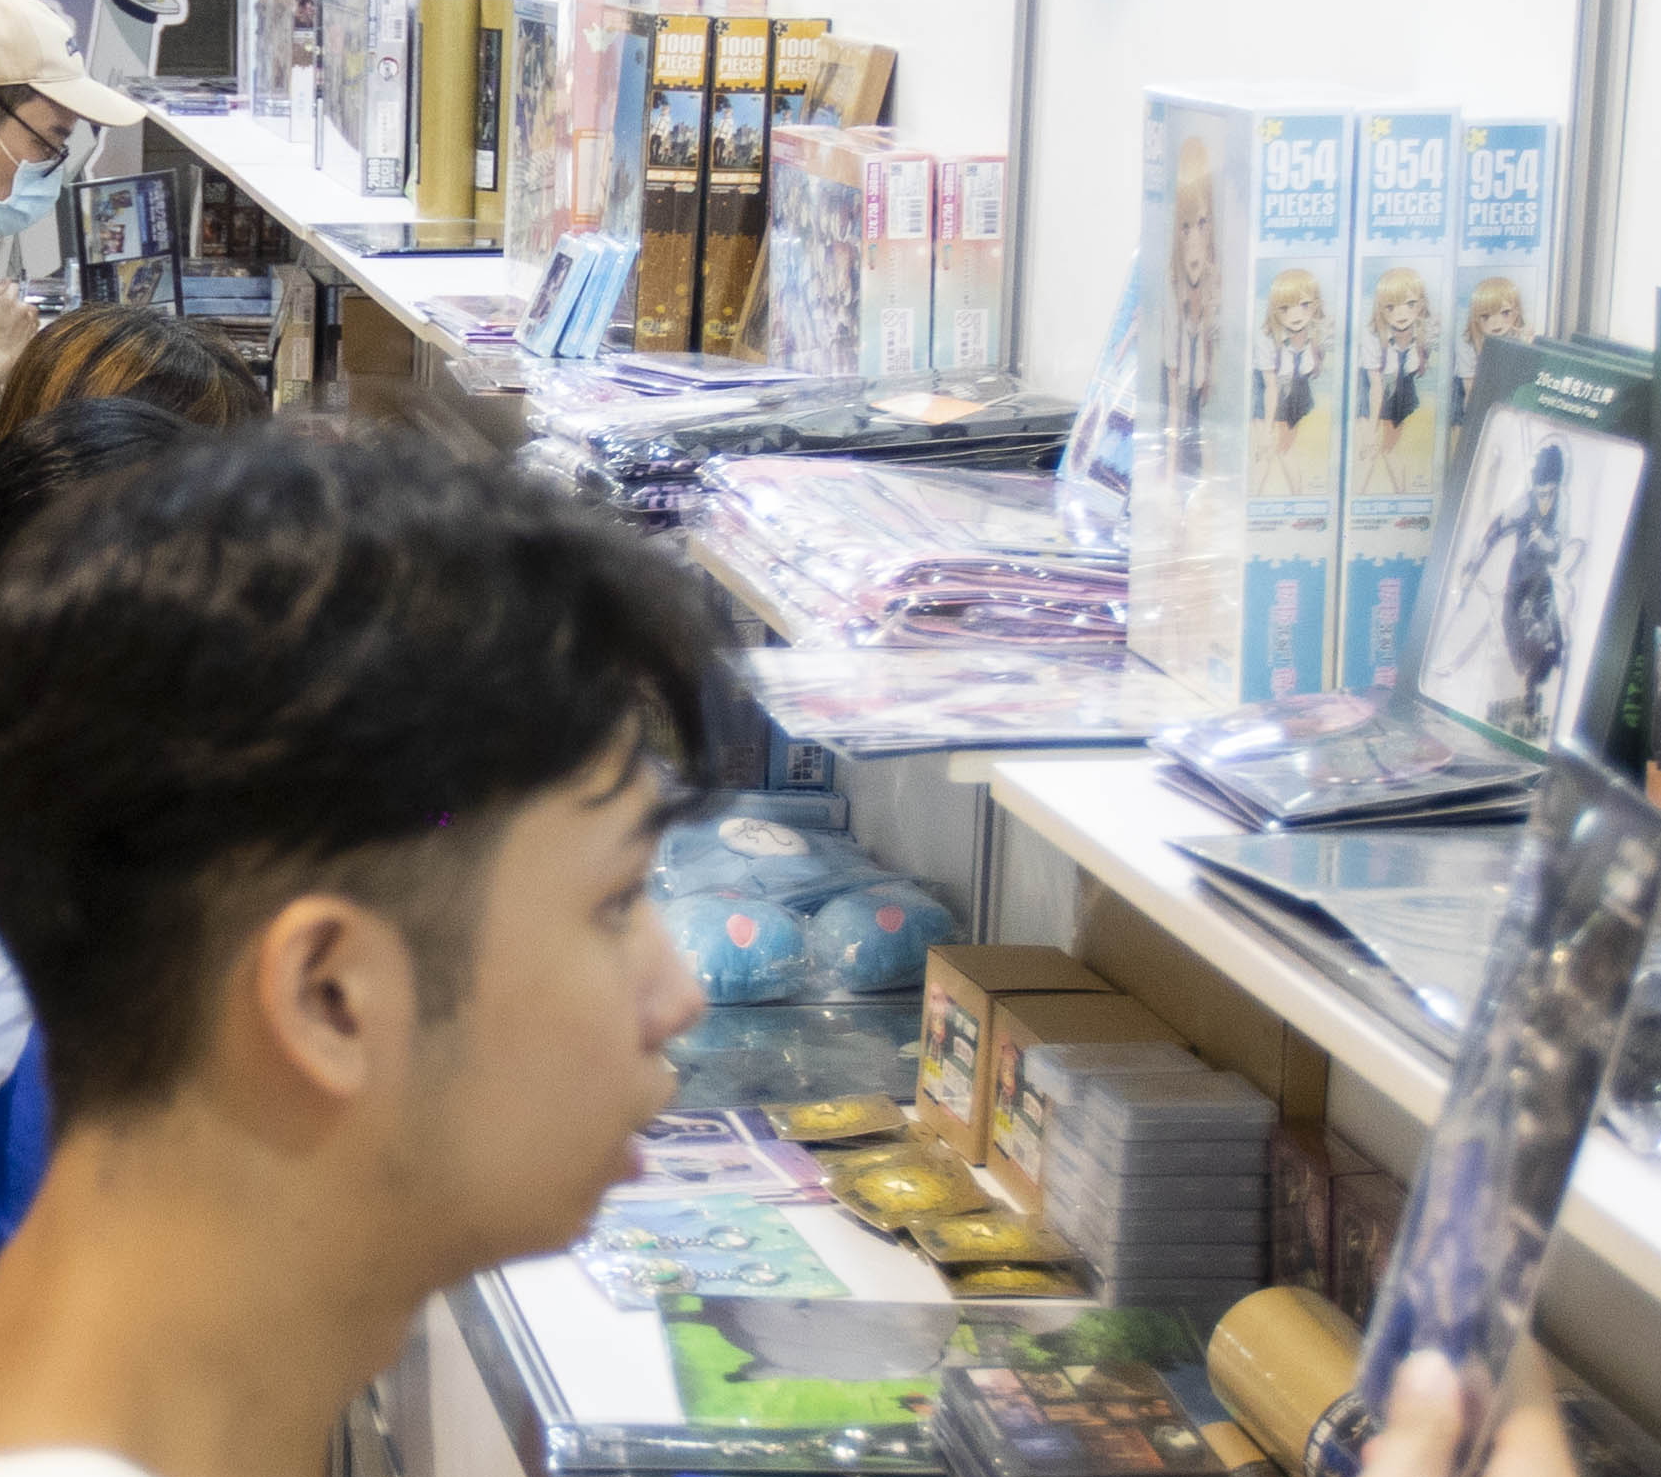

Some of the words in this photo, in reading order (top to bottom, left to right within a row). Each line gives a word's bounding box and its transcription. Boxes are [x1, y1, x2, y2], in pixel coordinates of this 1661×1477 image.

[719, 36, 766, 57] 1000
[1265, 138, 1339, 191] 954
[1373, 138, 1444, 190] 954
[1469, 149, 1539, 201] 954
[1264, 192, 1336, 216] PIECES
[1371, 191, 1443, 216] PIECES
[1468, 202, 1538, 226] PIECES
